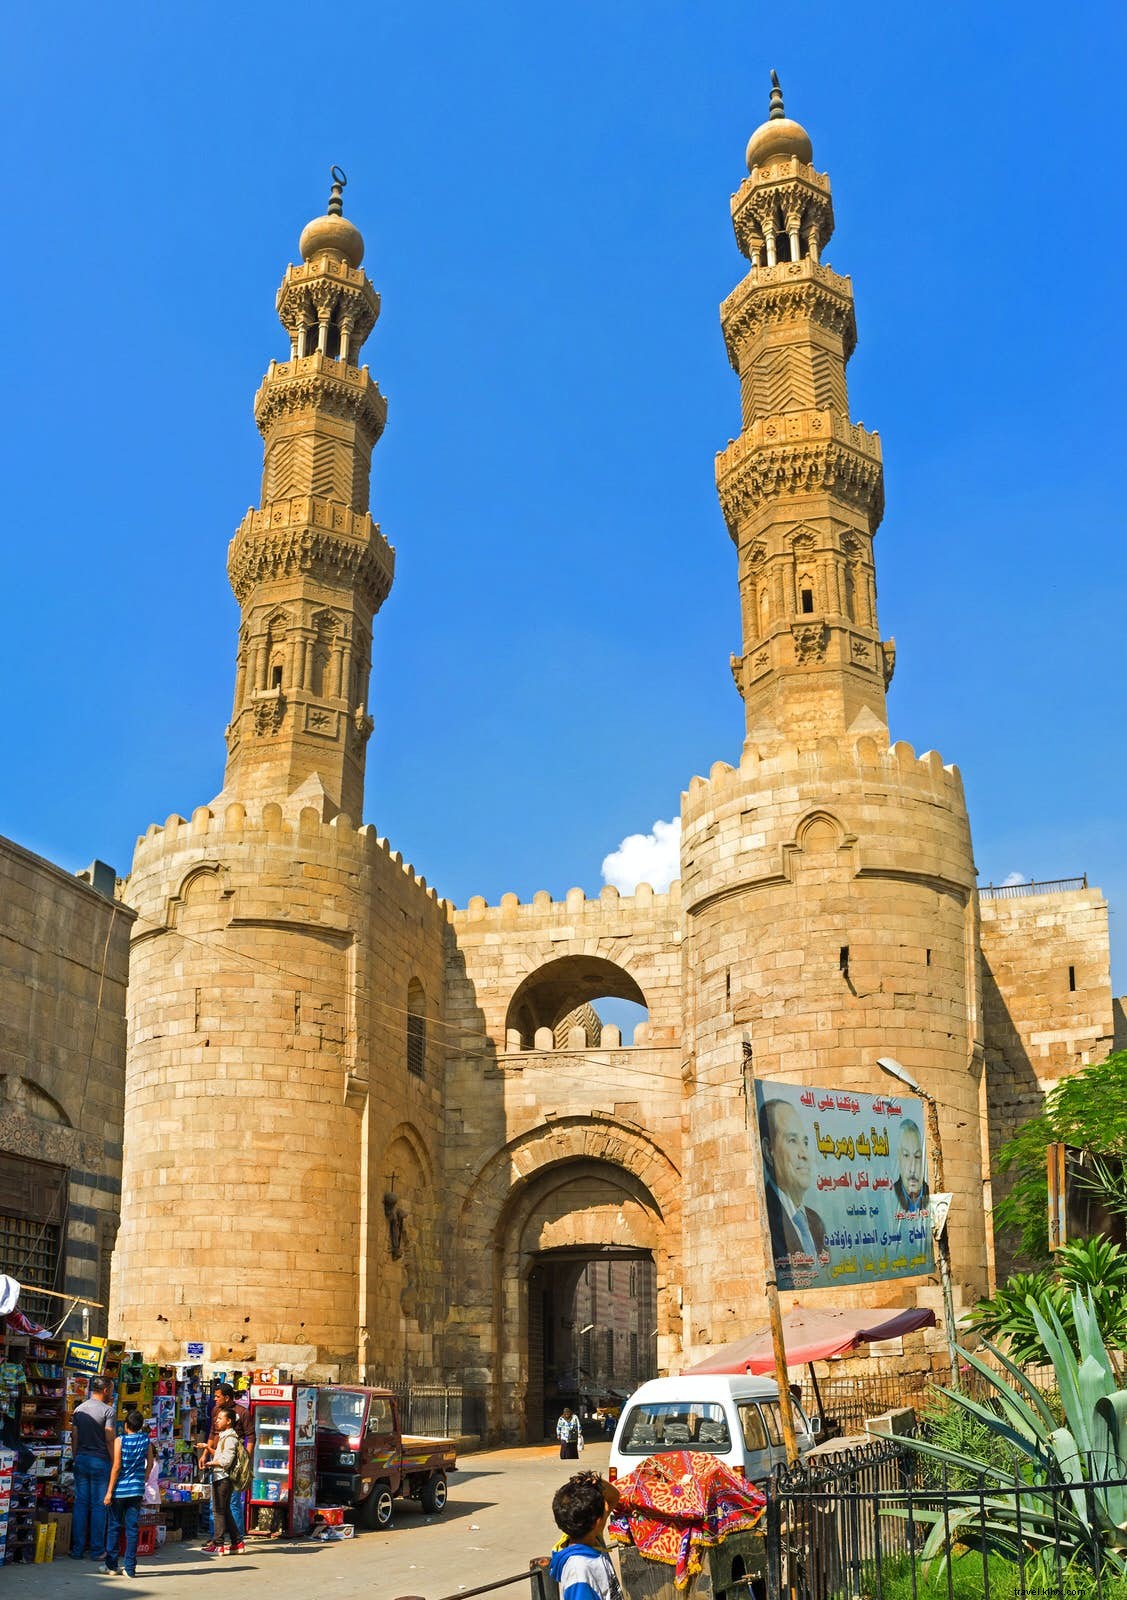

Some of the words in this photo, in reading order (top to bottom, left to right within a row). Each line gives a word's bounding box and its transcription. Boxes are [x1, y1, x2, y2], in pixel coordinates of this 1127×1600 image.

[800, 1090, 815, 1107] الله
[872, 1099, 885, 1114] الله
[886, 1104, 903, 1118] بسم
[856, 1131, 871, 1161] بك
[855, 1171, 869, 1191] لكل
[846, 1203, 867, 1216] تحيات
[869, 1206, 880, 1218] مع
